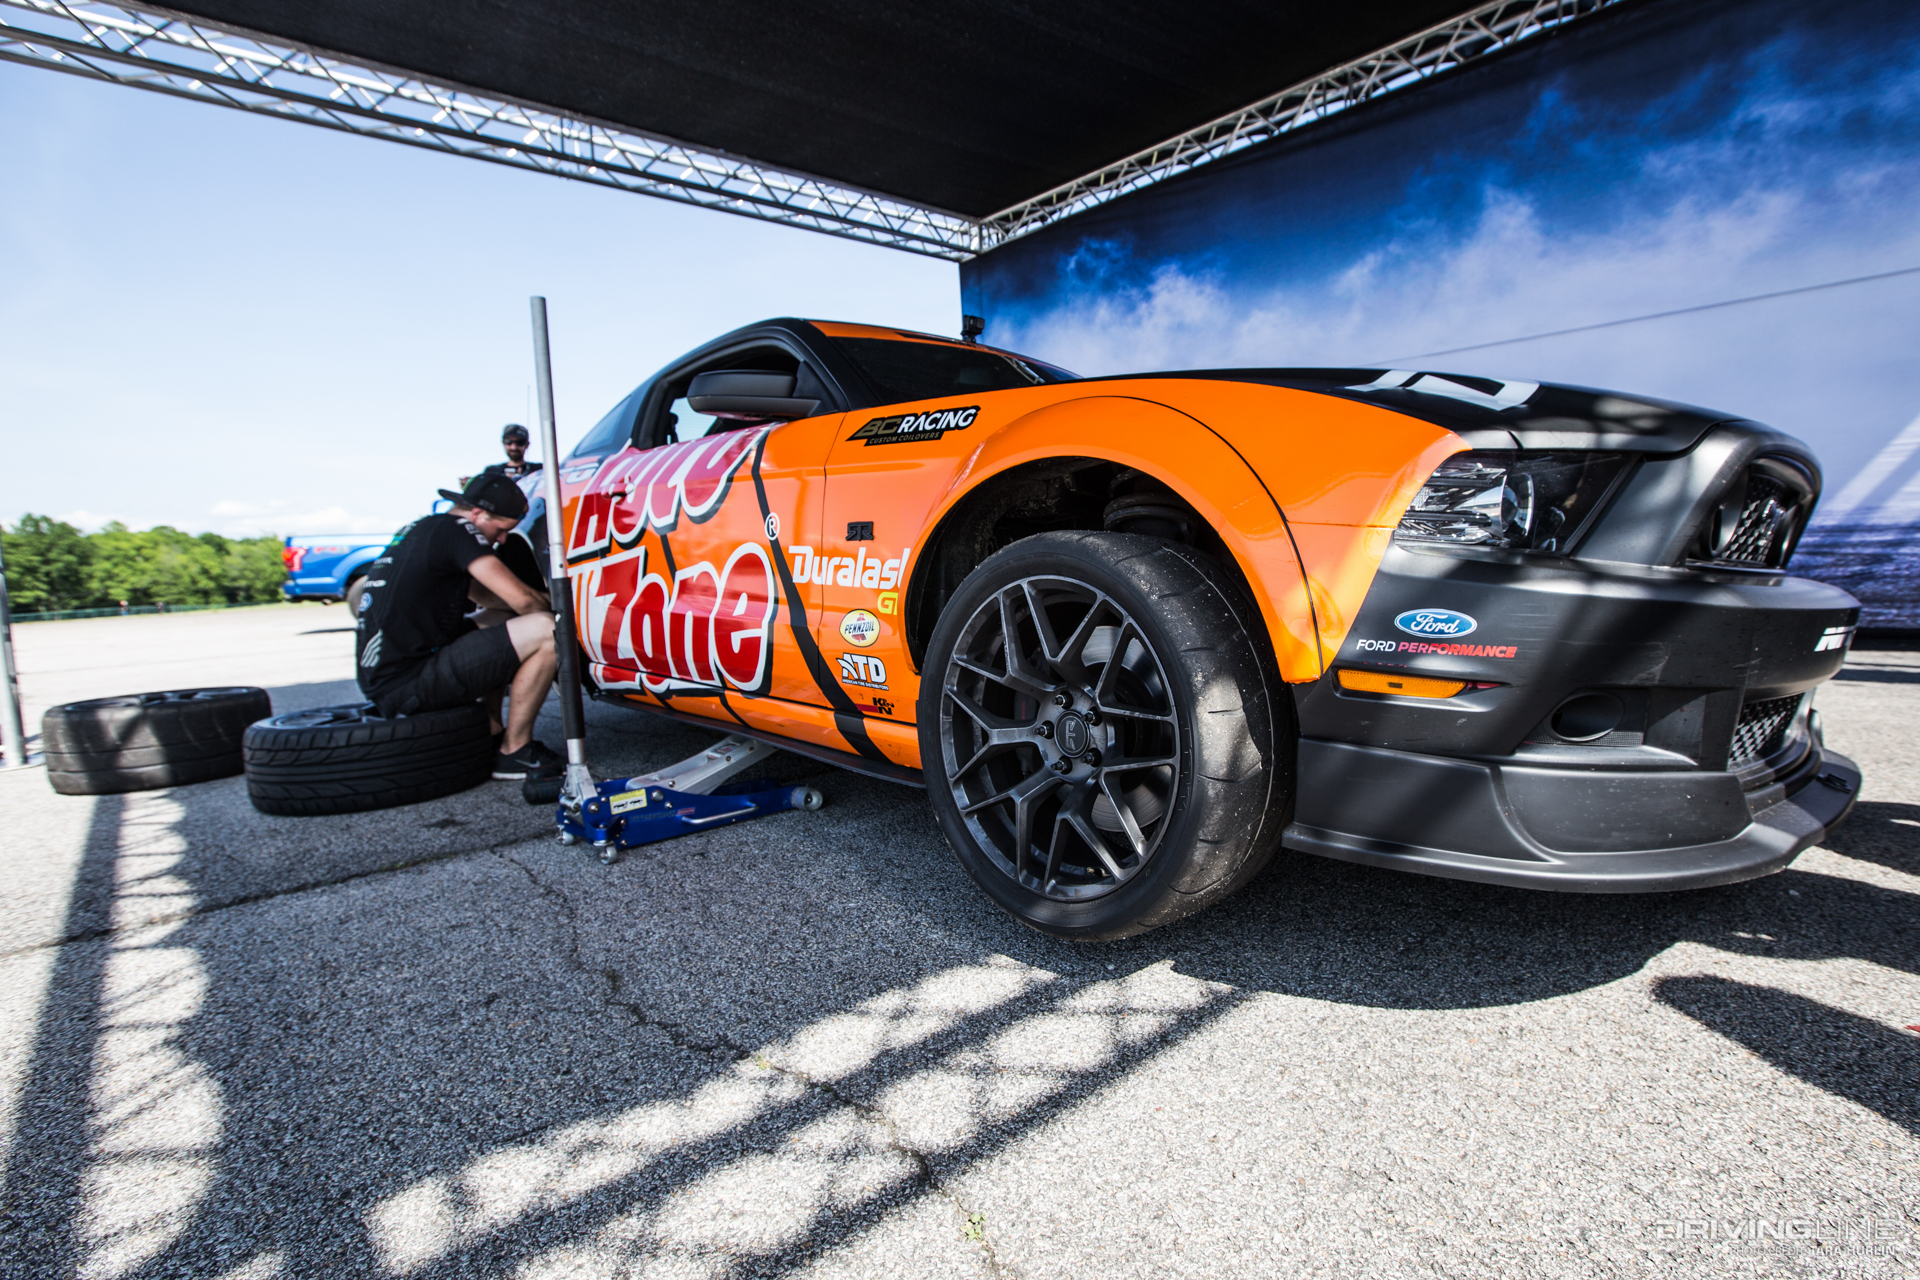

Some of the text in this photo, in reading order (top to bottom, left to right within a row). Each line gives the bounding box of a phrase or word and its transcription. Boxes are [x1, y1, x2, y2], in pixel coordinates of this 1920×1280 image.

[897, 408, 977, 434] RACING
[869, 431, 940, 445] CUSTOM COILOVERS
[588, 542, 776, 692] Zone
[844, 620, 875, 634] PENNZOIL
[1410, 612, 1460, 634] Ford
[1356, 639, 1518, 658] FORD PERFORMANCE
[836, 652, 886, 684] ATD
